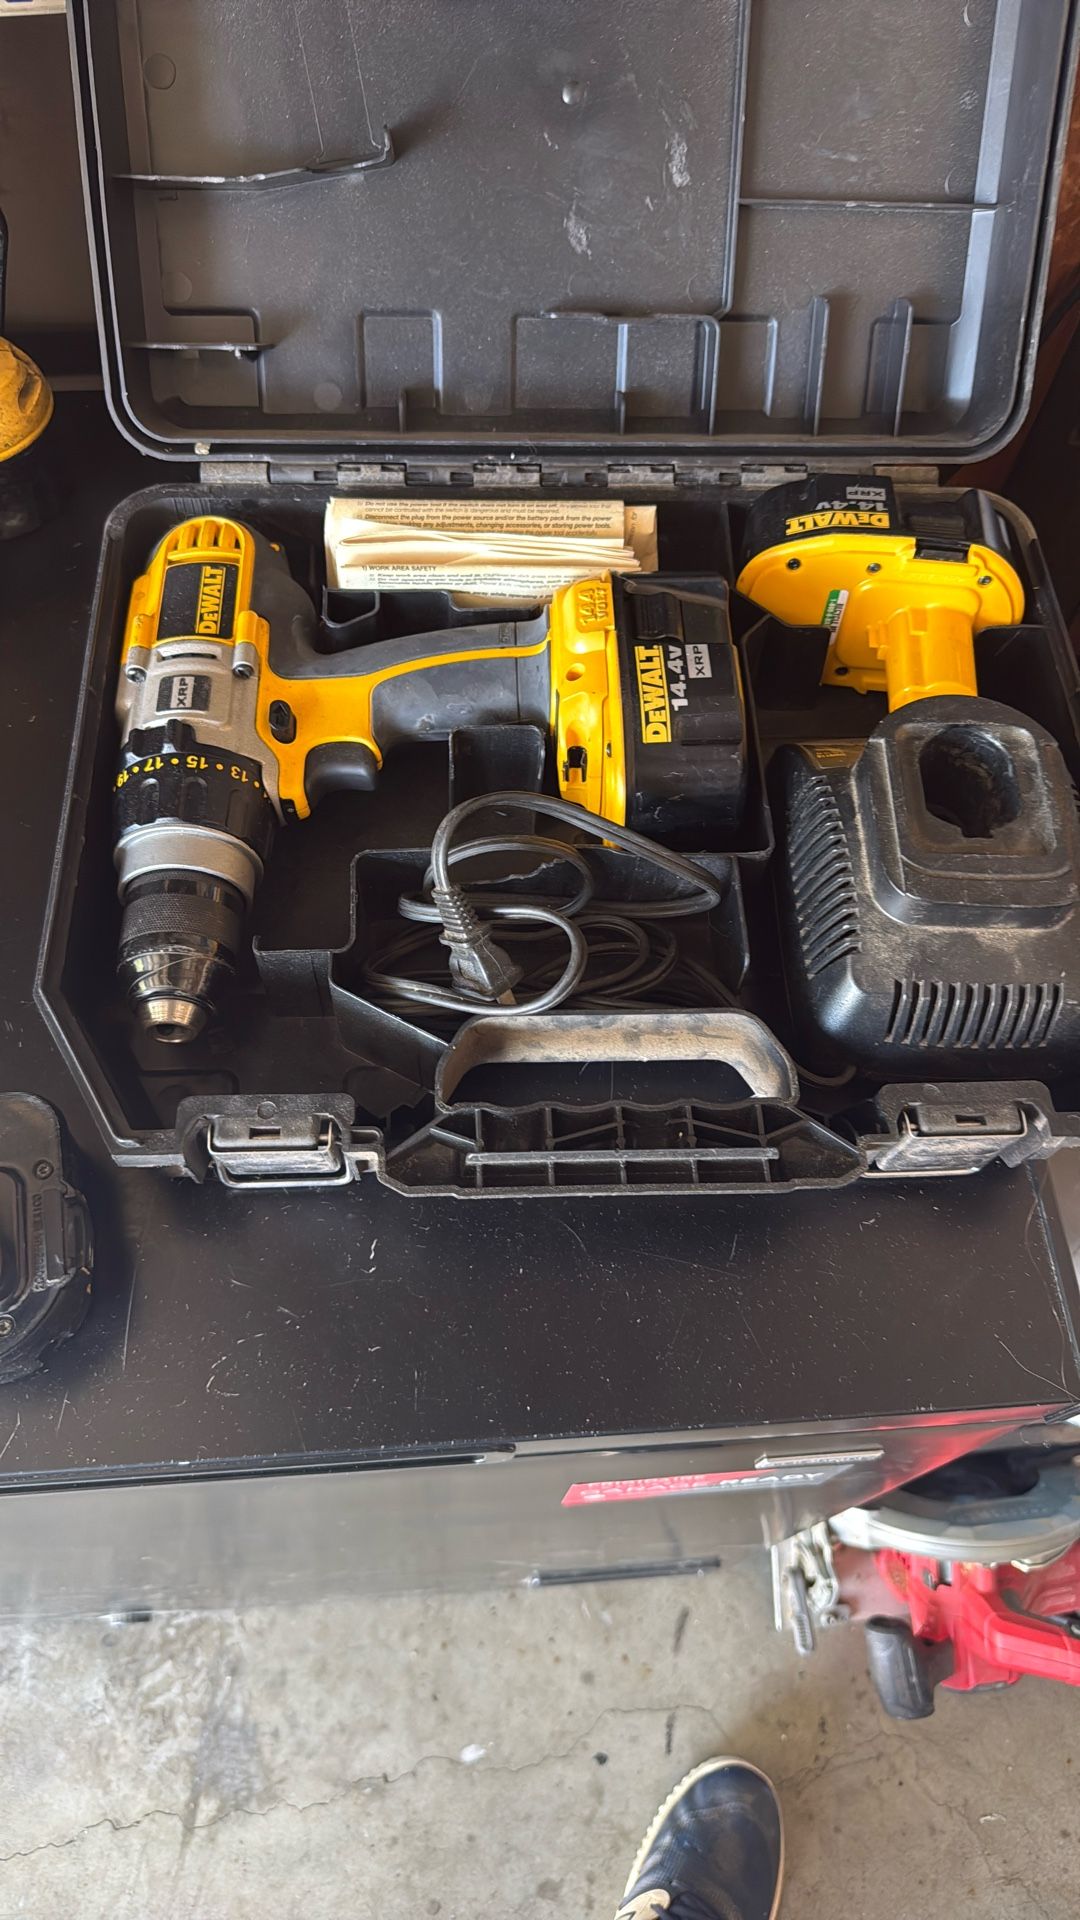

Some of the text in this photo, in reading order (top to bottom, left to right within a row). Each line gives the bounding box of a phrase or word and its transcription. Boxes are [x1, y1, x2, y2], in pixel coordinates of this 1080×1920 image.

[786, 512, 889, 534] DEWALT
[199, 566, 223, 634] DEWALT
[695, 645, 707, 676] XRP
[176, 677, 188, 707] XRP
[639, 645, 669, 743] DEWALT
[667, 645, 689, 711] 14.4V
[116, 755, 249, 787] 13 15 17 19
